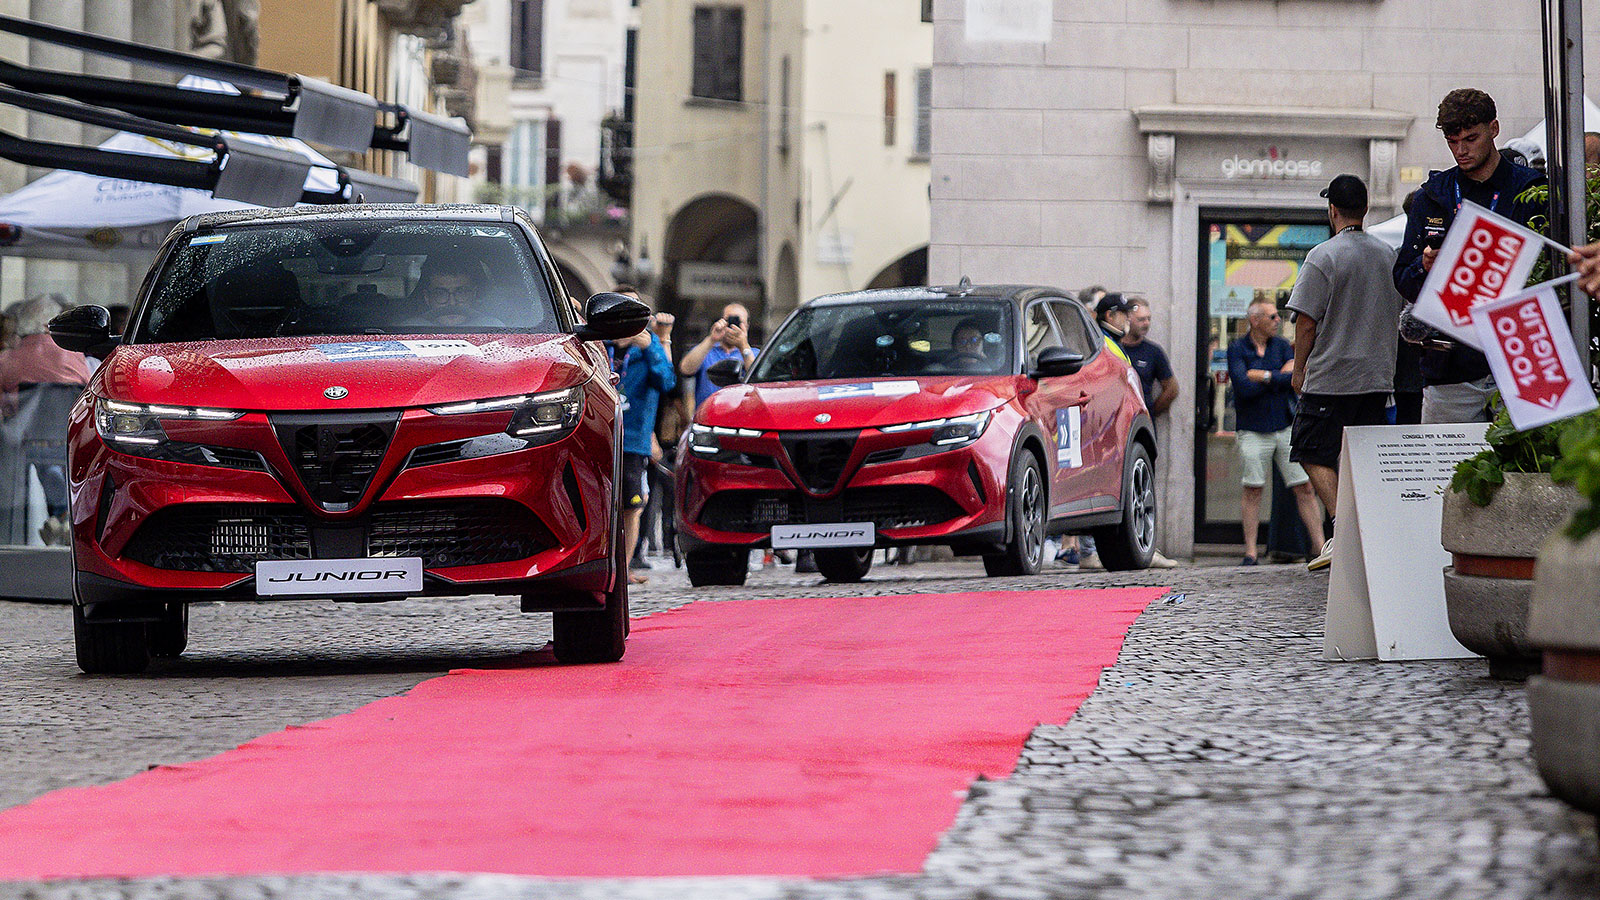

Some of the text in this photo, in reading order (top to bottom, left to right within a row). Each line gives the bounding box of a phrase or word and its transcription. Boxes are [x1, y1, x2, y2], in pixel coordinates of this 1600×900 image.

[1221, 154, 1323, 178] glamcase
[1449, 228, 1493, 296] 1000
[1496, 316, 1536, 386] 1000
[1518, 301, 1565, 383] MIGLIA
[780, 530, 865, 540] JUNIOR
[268, 570, 408, 582] JUNIOR
